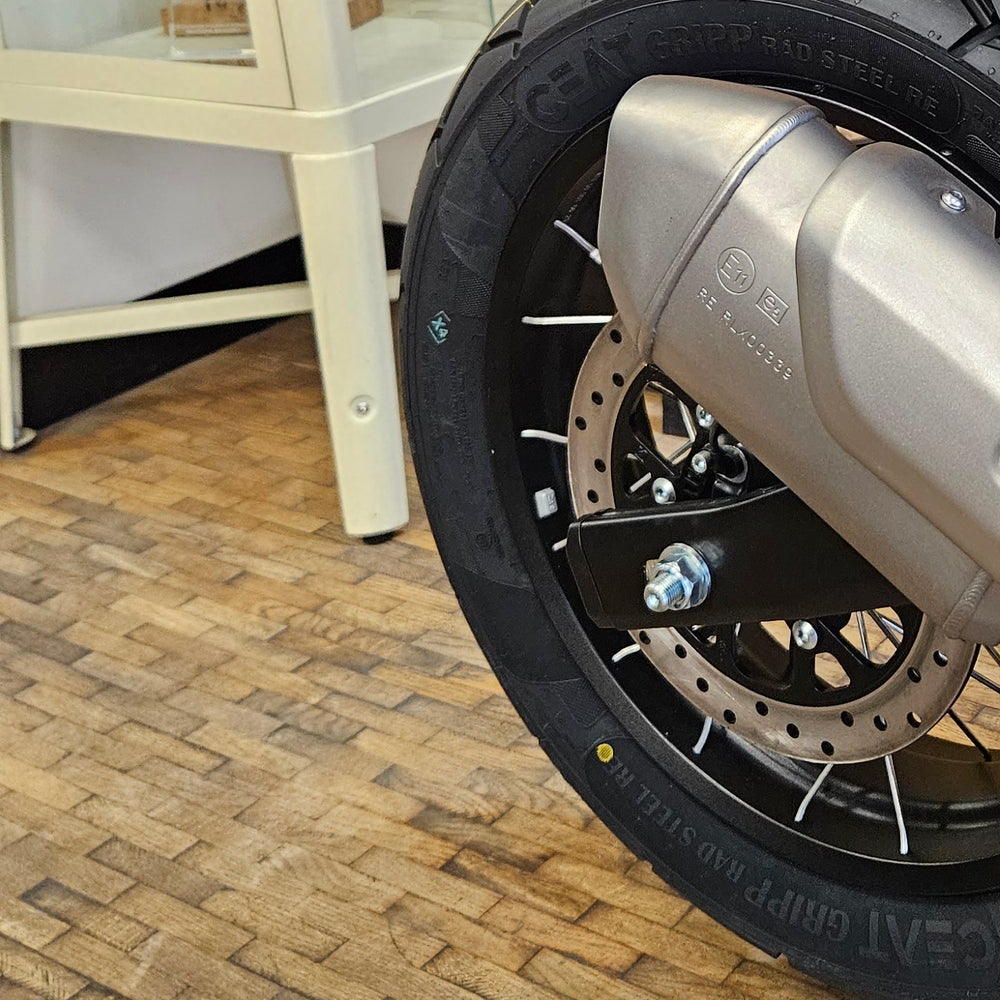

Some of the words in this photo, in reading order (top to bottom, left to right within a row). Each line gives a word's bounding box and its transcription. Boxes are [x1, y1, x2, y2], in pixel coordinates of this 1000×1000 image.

[821, 49, 899, 97] STEEL
[906, 84, 940, 118] RE
[635, 783, 697, 847] STEEL
[698, 841, 746, 883] RAD
[744, 878, 850, 942] GRIPP
[859, 911, 1000, 969] CEAT
